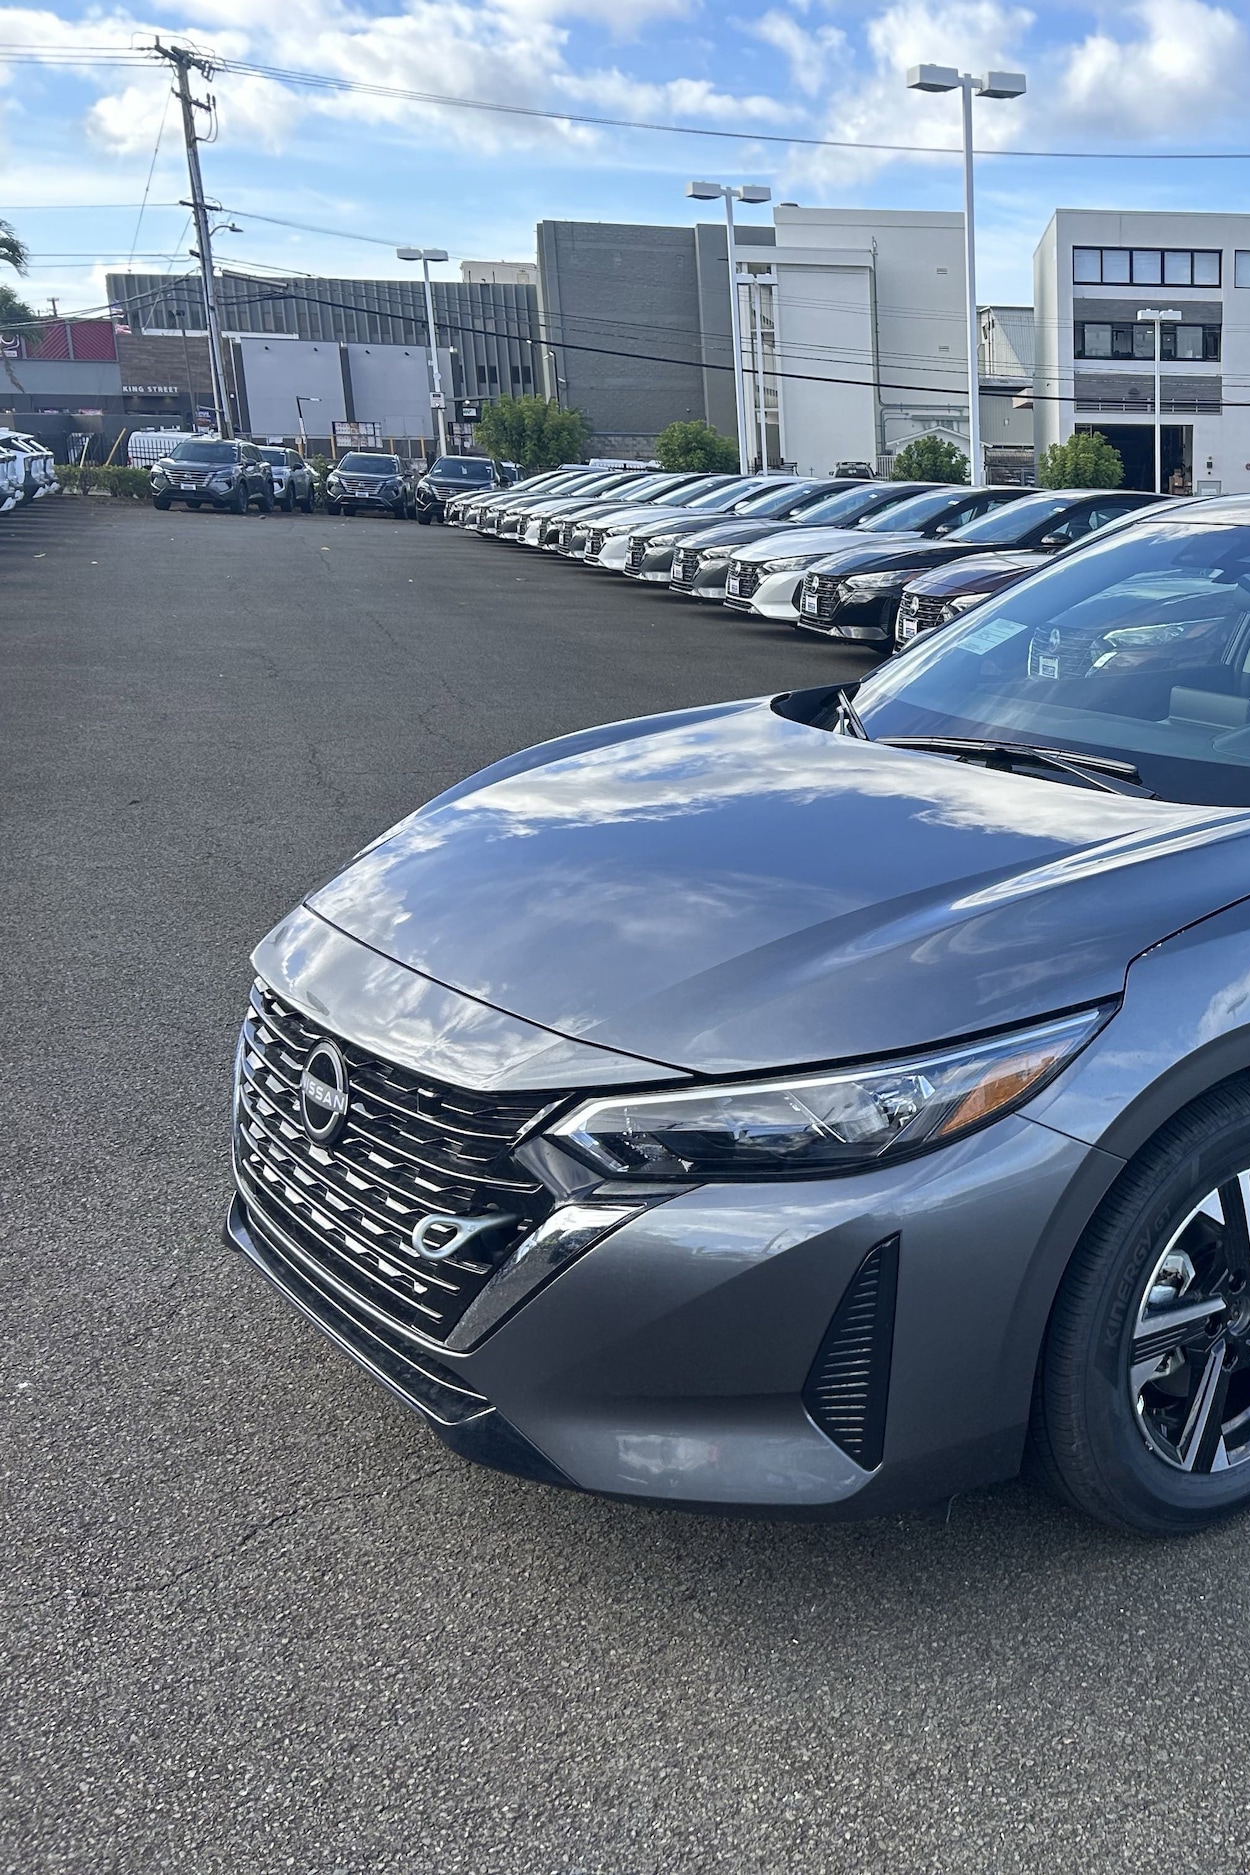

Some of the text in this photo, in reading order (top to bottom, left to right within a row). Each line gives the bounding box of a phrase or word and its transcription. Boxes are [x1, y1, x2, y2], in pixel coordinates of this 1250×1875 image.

[122, 385, 144, 393] KING
[301, 1072, 344, 1110] NISSAN
[1104, 1202, 1172, 1346] KINERGY GT
